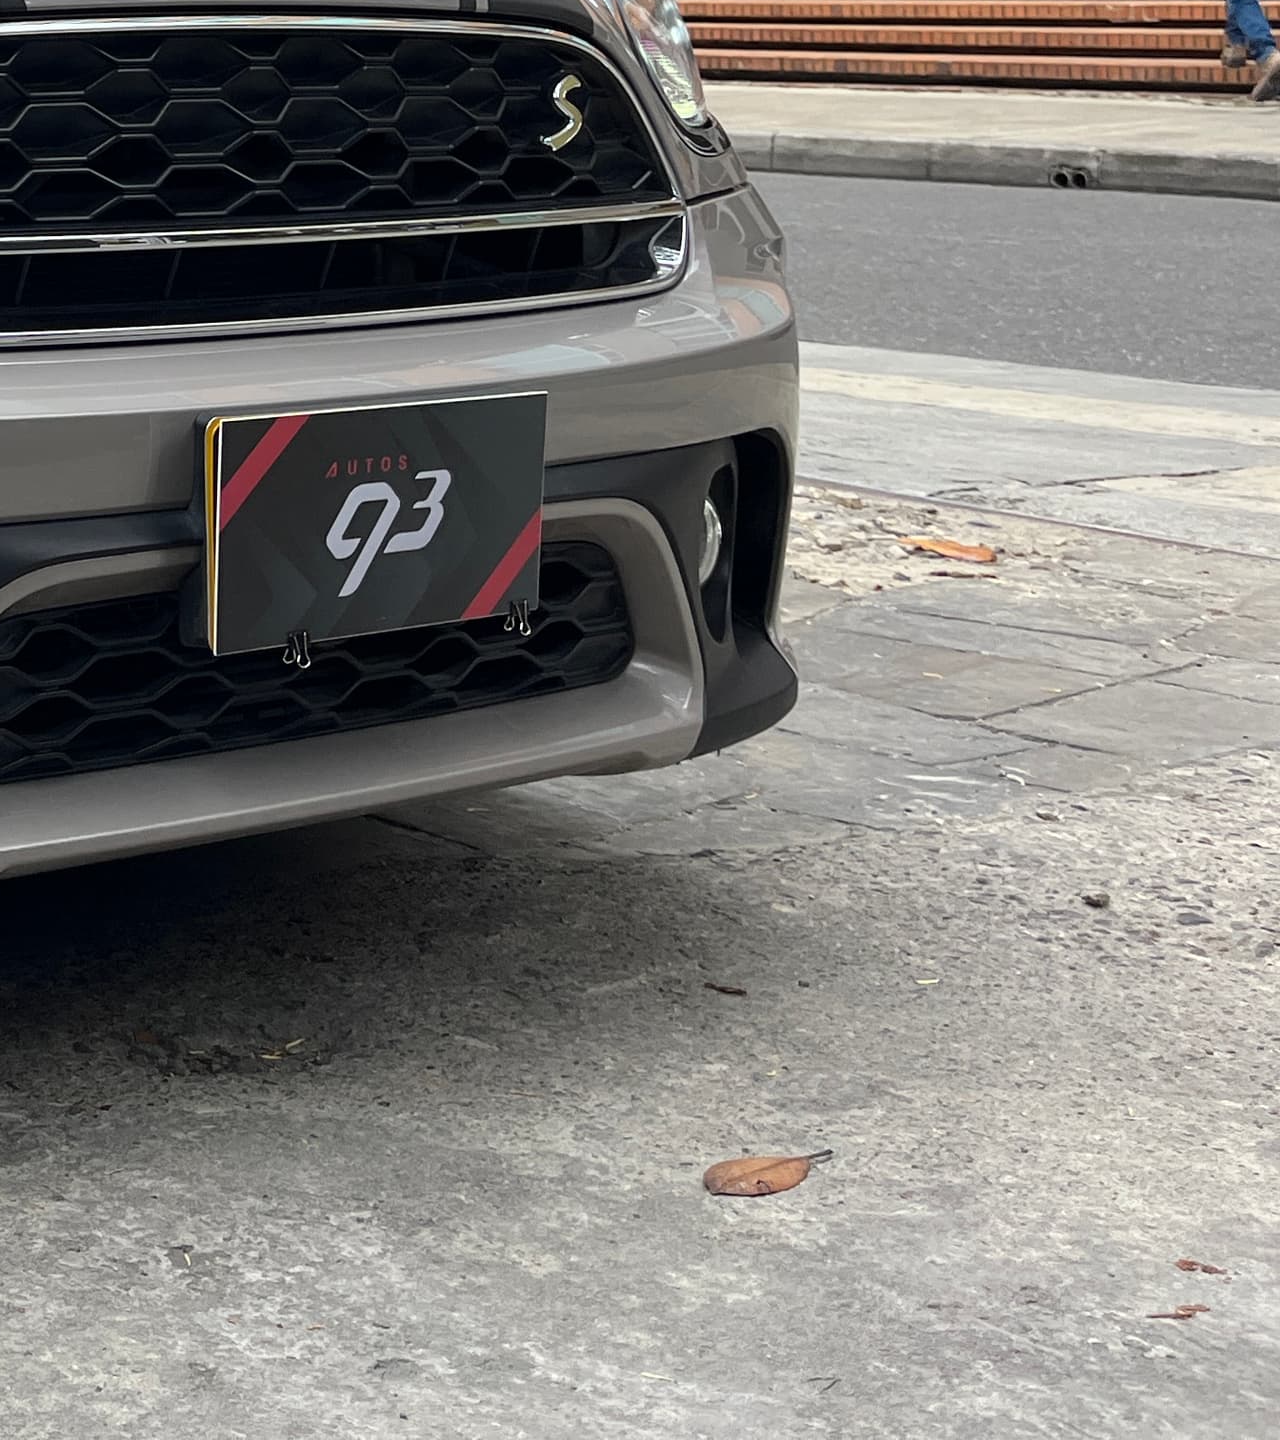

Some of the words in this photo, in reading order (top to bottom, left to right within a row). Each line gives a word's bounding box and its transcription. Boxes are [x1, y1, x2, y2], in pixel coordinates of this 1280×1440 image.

[543, 74, 582, 151] S
[325, 454, 410, 479] AUTOS
[326, 469, 452, 598] 93
